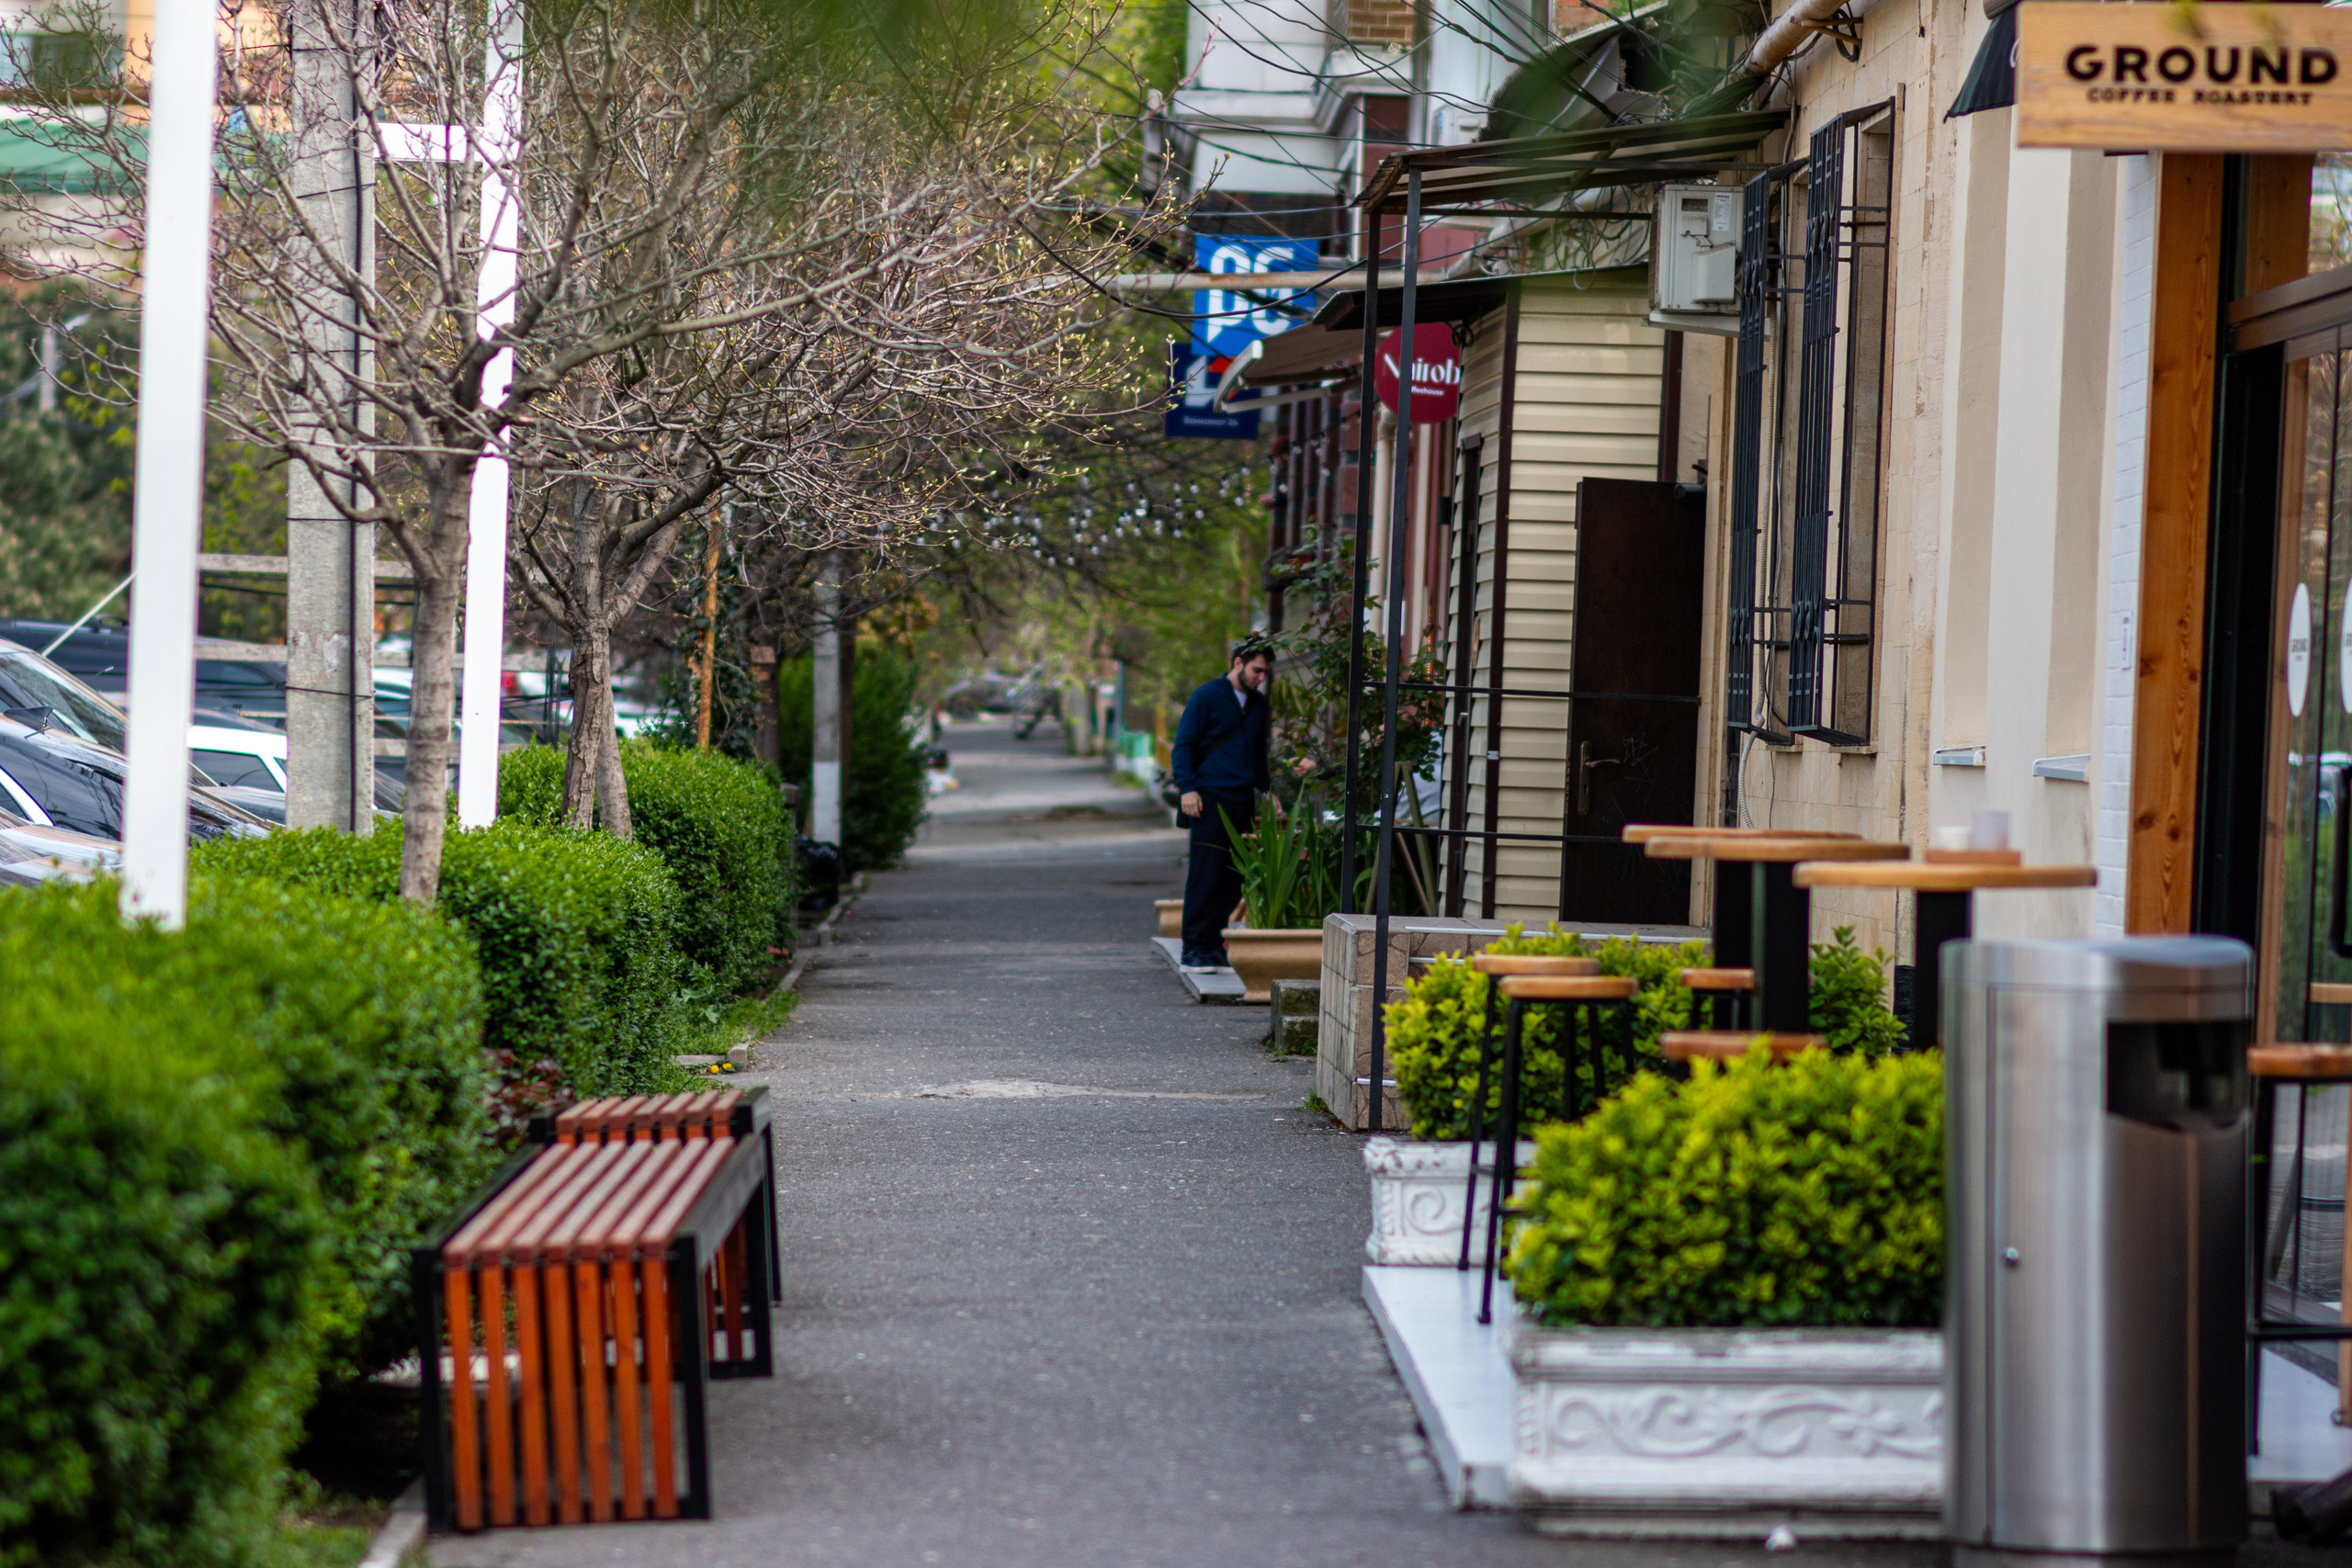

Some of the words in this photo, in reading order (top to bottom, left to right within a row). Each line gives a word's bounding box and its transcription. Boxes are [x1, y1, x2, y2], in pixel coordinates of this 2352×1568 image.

[2066, 45, 2338, 85] GROUND
[2086, 87, 2177, 103] COFFEE
[2193, 89, 2313, 106] ROASTERY
[1183, 415, 1227, 426] Банкомат
